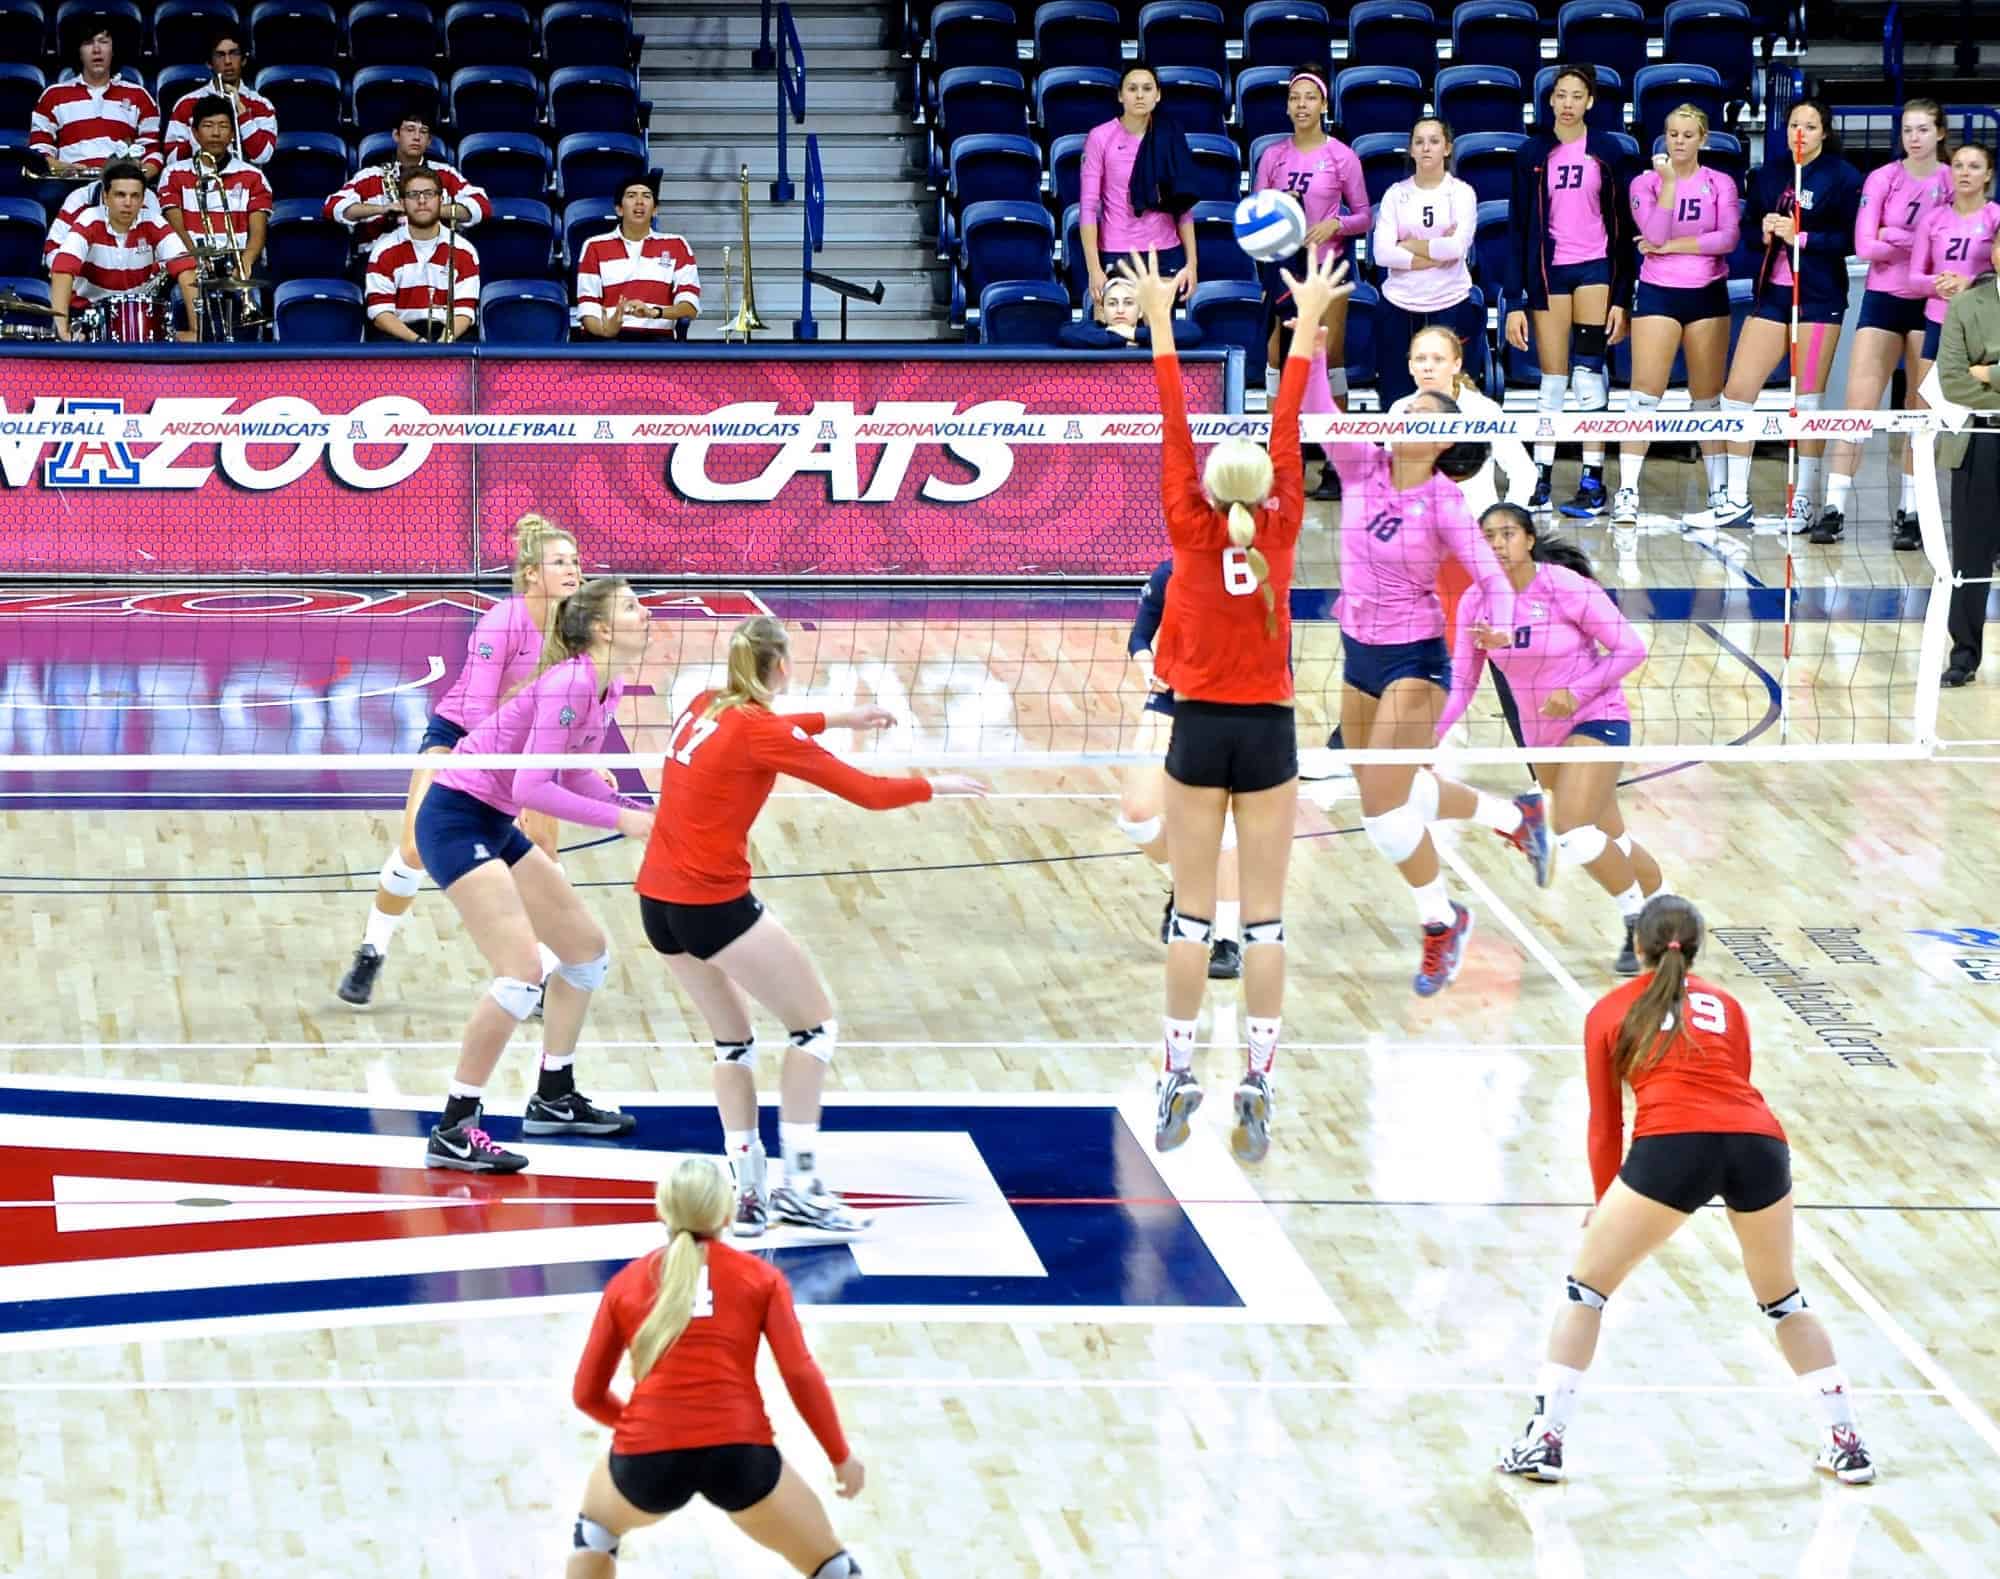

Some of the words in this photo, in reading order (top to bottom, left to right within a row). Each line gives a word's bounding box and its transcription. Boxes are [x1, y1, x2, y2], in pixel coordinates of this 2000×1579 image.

[1281, 172, 1314, 195] 35
[1554, 165, 1584, 190] 33
[1422, 205, 1434, 228] 5
[1678, 198, 1702, 223] 15
[1905, 201, 1921, 225] 7
[1945, 238, 1971, 261] 21
[670, 400, 1027, 503] CATS
[1221, 547, 1258, 597] 6
[665, 711, 720, 769] 17
